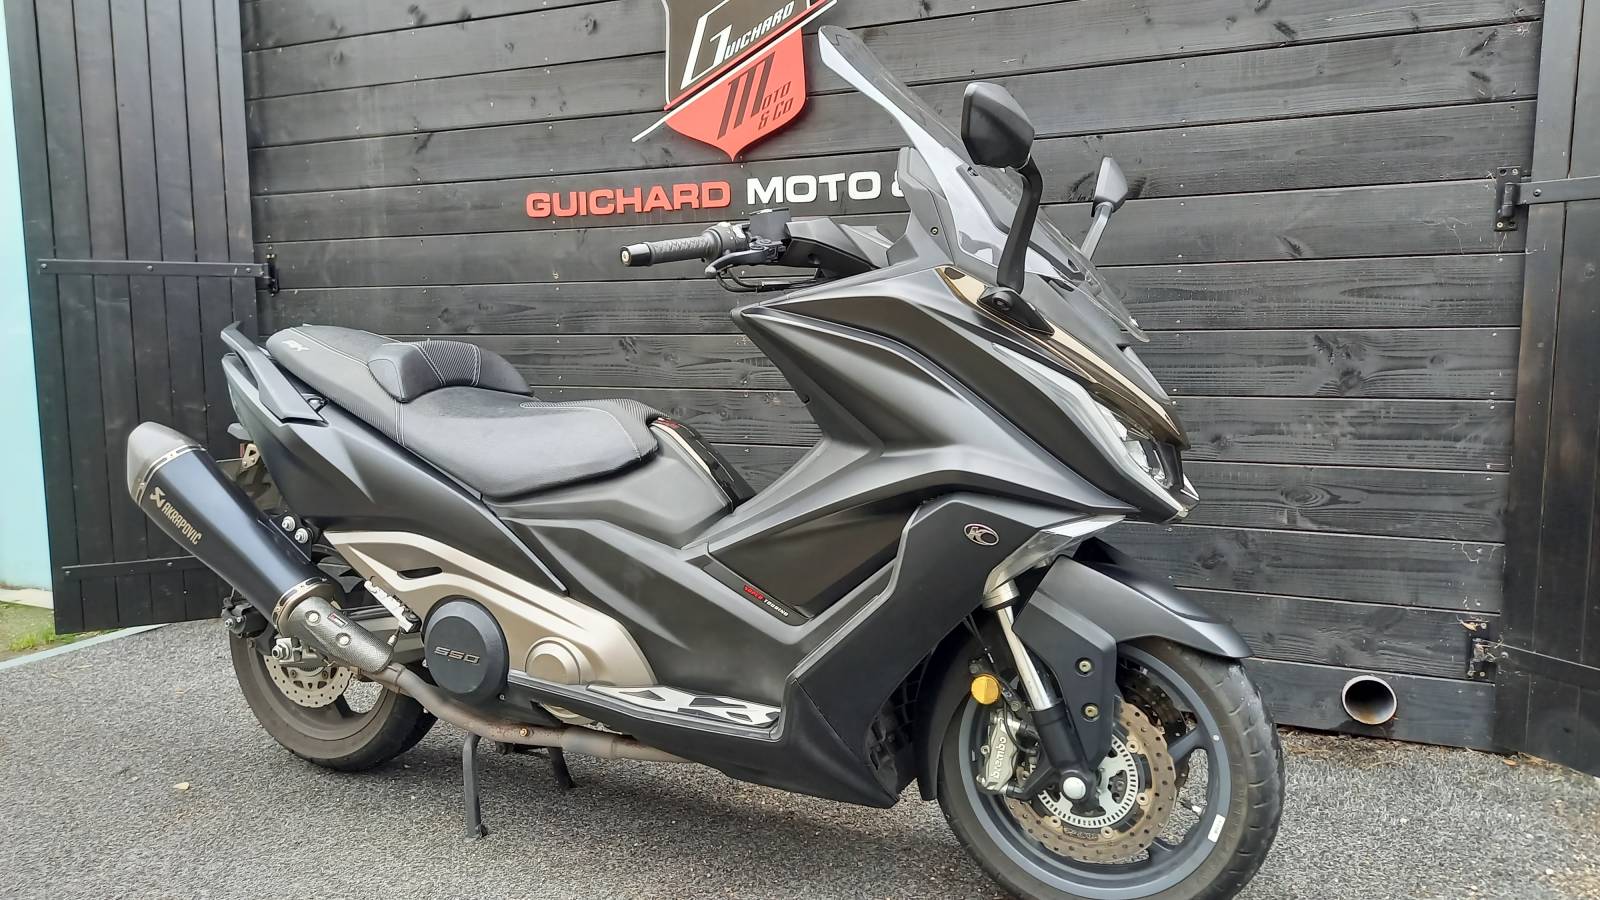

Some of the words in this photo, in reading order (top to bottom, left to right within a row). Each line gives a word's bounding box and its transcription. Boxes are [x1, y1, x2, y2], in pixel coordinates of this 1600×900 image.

[717, 51, 792, 141] MOTO
[758, 110, 770, 131] &
[772, 97, 794, 121] CO
[525, 181, 732, 218] GUICHARD
[746, 171, 882, 205] MOTO
[434, 646, 480, 664] 550
[990, 736, 1007, 779] brembo
